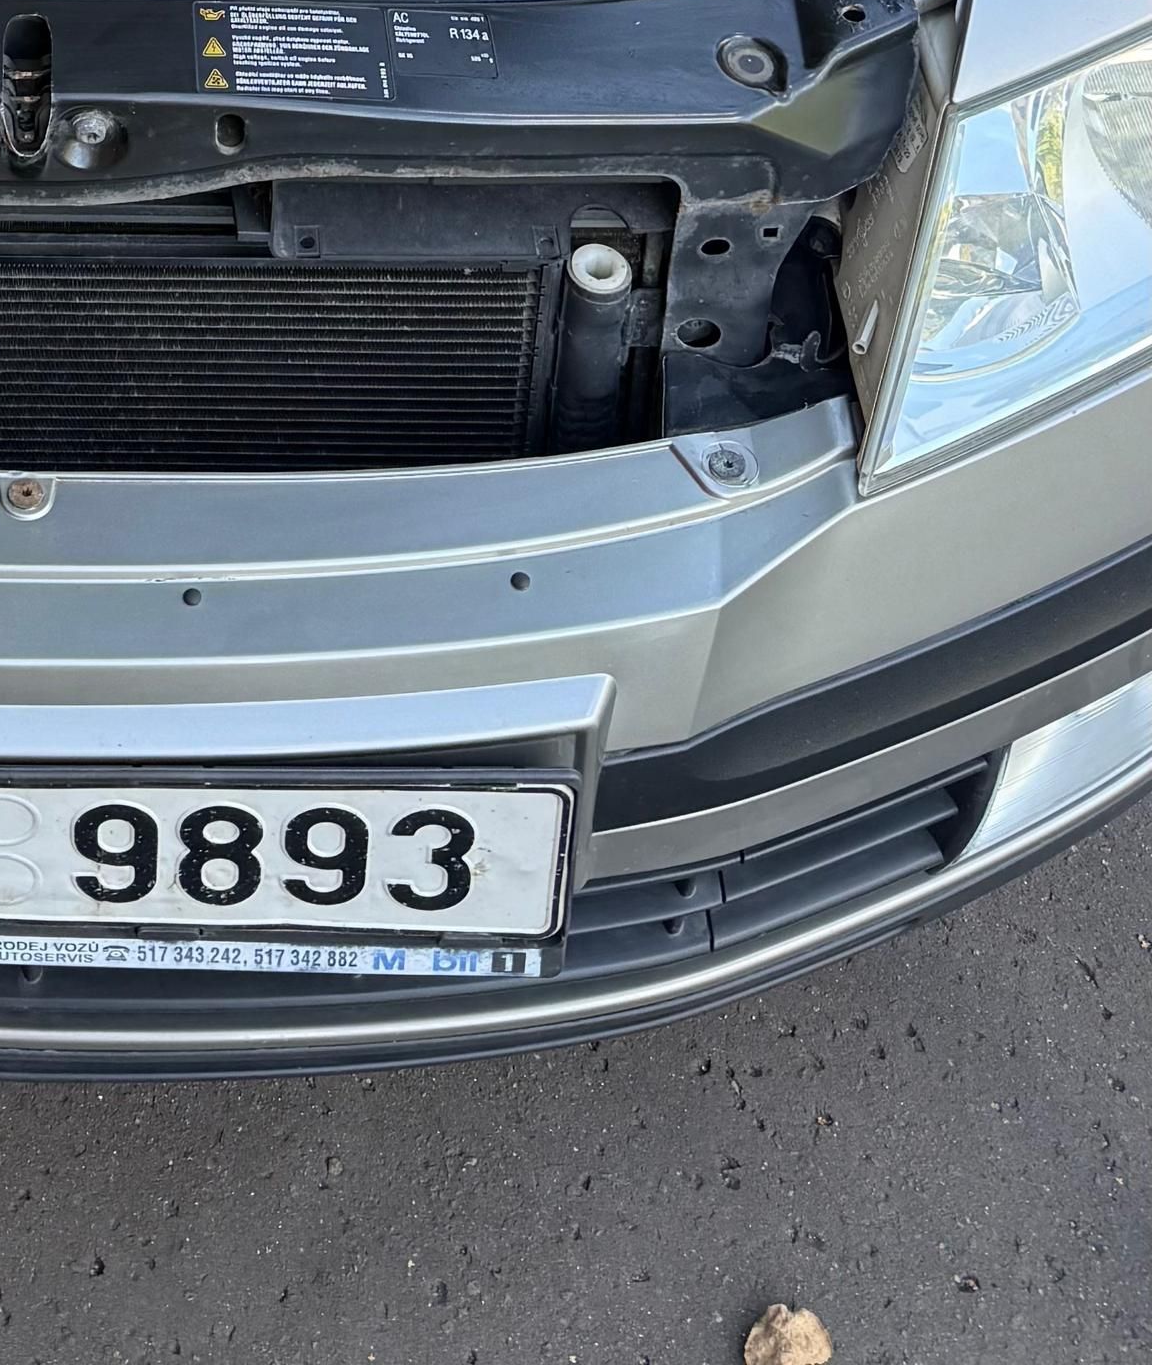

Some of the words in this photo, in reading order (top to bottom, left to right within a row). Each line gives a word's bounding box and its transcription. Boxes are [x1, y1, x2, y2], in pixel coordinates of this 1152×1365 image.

[392, 11, 409, 24] AC
[449, 27, 459, 40] R
[460, 28, 480, 41] 134
[73, 803, 476, 912] 9893
[54, 940, 99, 953] VOZŮ
[137, 946, 168, 962] 517
[173, 947, 205, 963] 343
[253, 948, 284, 966] 517
[290, 950, 322, 967] 342
[326, 950, 358, 968] 882
